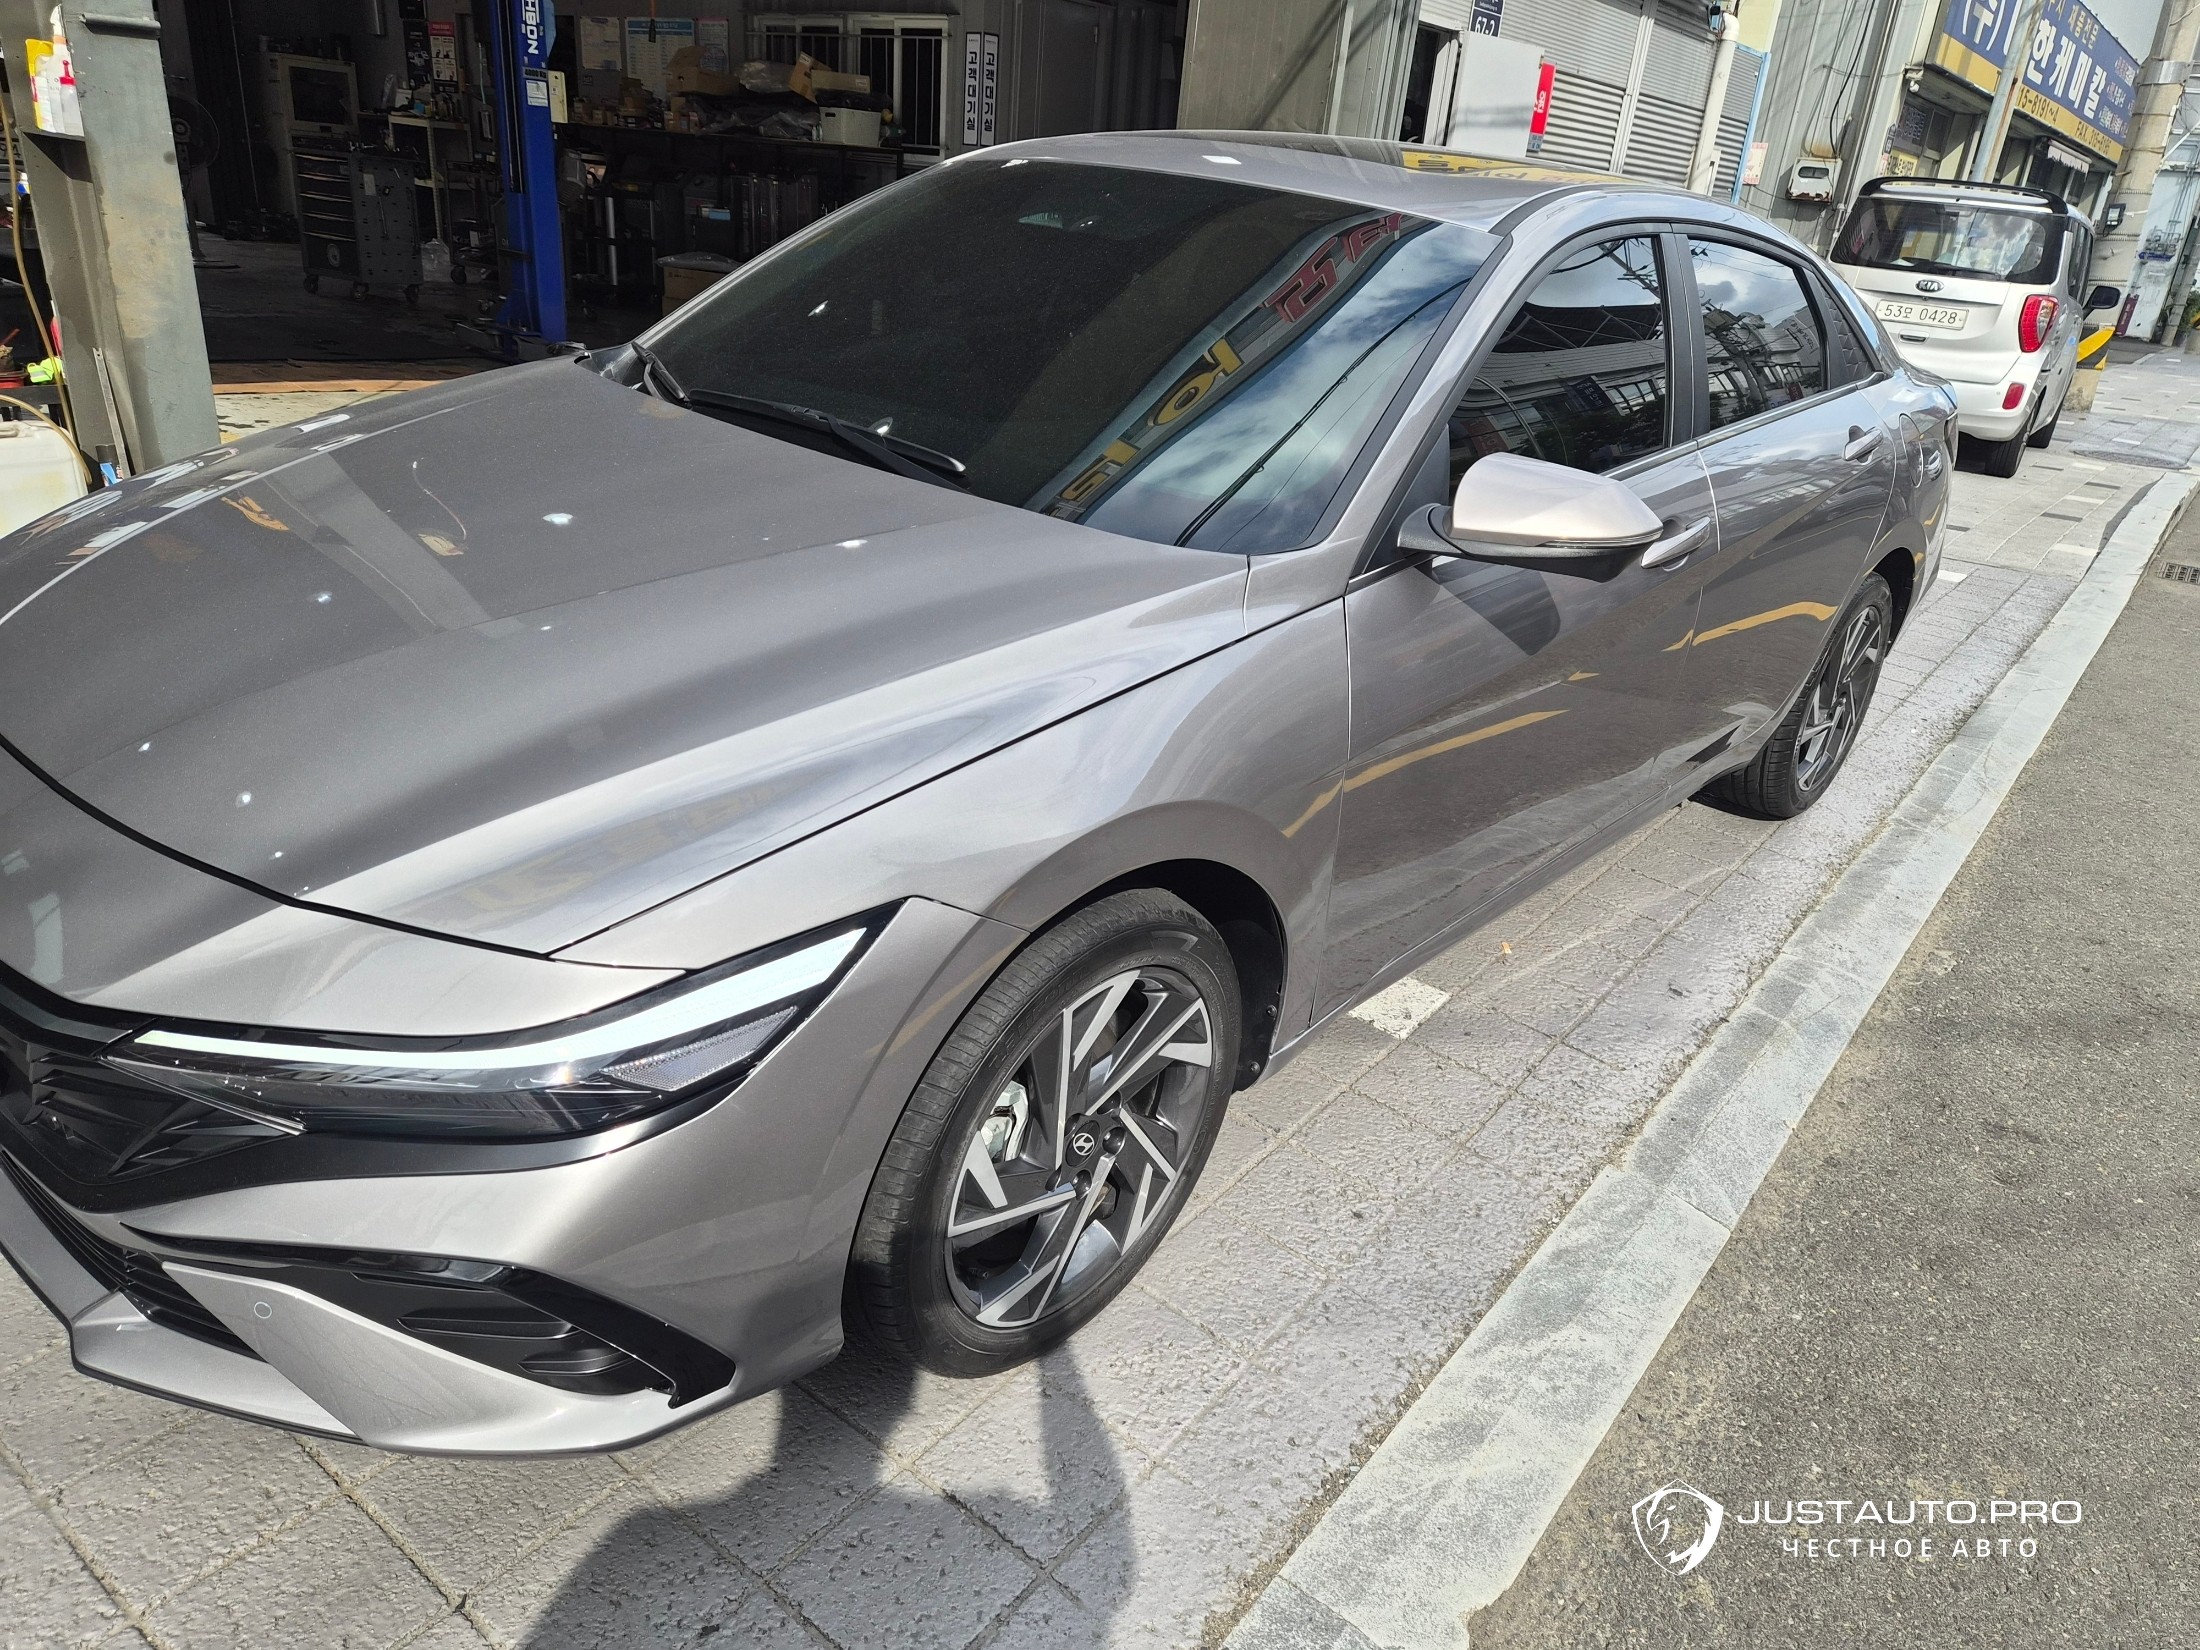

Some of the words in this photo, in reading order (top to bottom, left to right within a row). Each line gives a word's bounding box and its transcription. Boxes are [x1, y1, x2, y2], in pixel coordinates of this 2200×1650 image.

[966, 51, 978, 131] 고객대기실
[984, 52, 995, 132] 고객대기실
[1918, 281, 1939, 291] KIA
[1884, 304, 1913, 319] 53모
[1919, 308, 1958, 325] 0428
